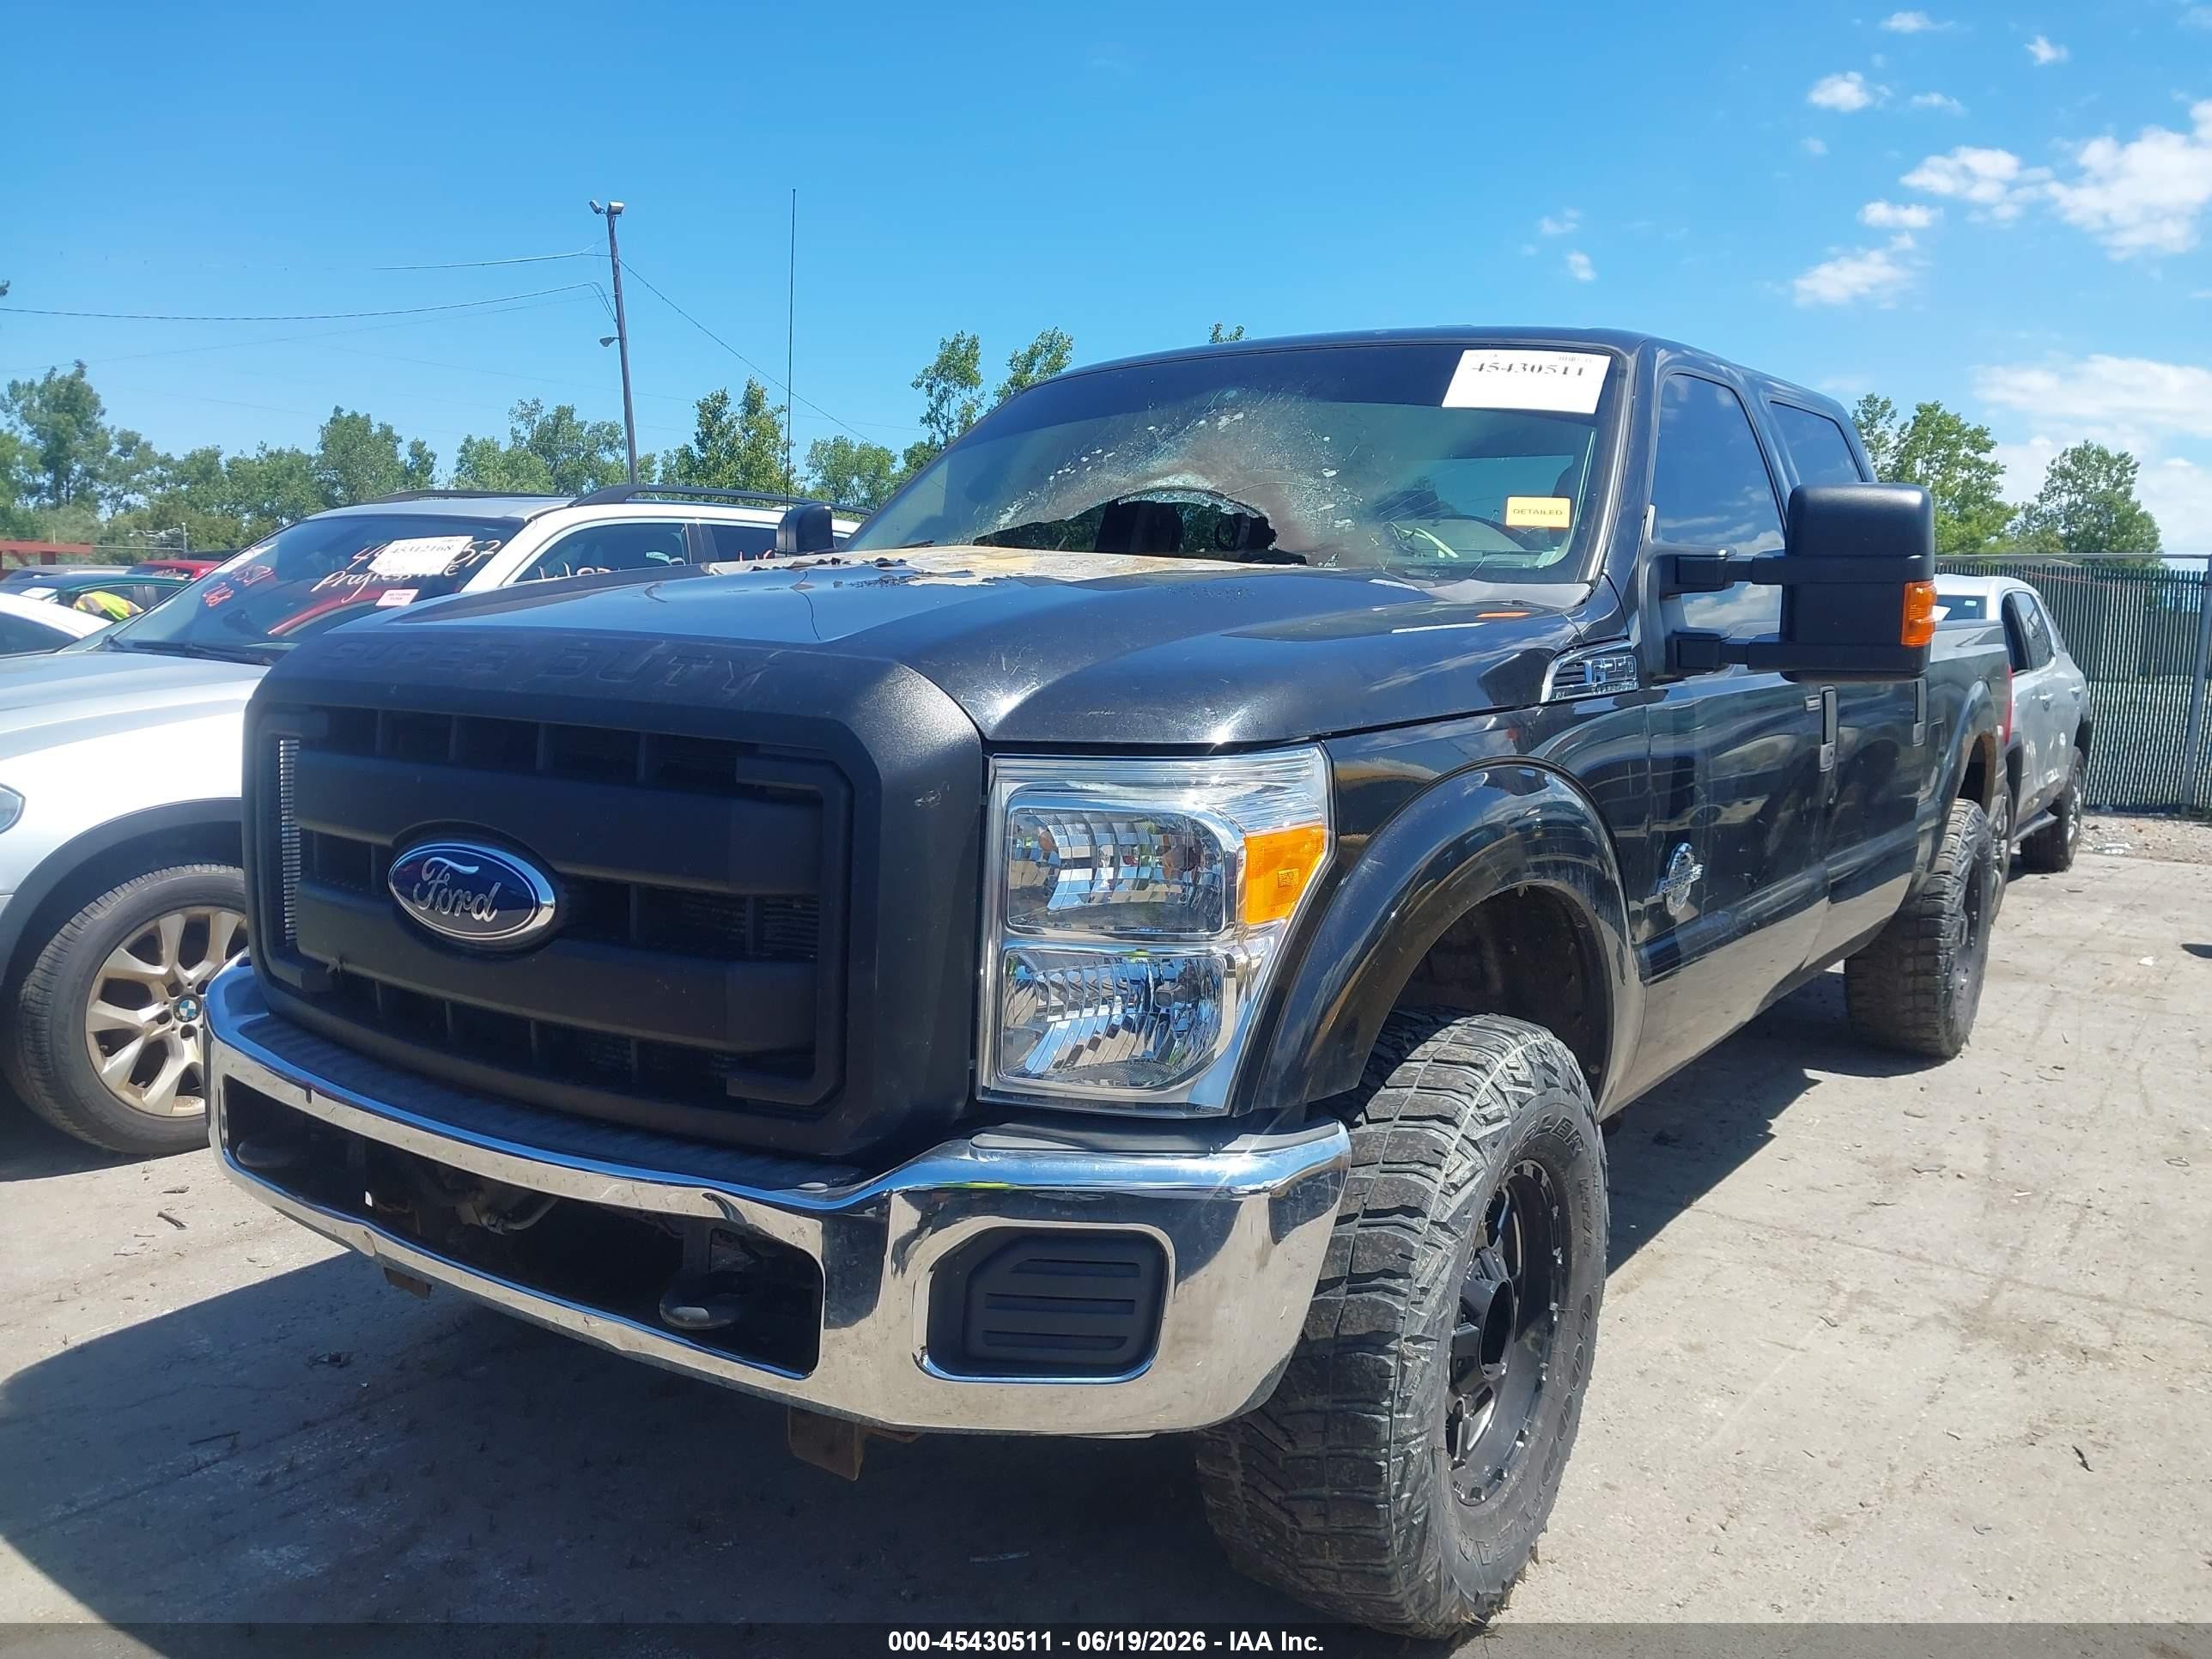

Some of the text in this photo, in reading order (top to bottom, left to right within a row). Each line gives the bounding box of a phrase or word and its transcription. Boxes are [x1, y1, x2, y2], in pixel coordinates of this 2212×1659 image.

[1472, 362, 1584, 376] 45430511
[310, 564, 459, 603] Progresse
[323, 640, 781, 694] SUPER DUTY
[413, 856, 501, 923] Ford
